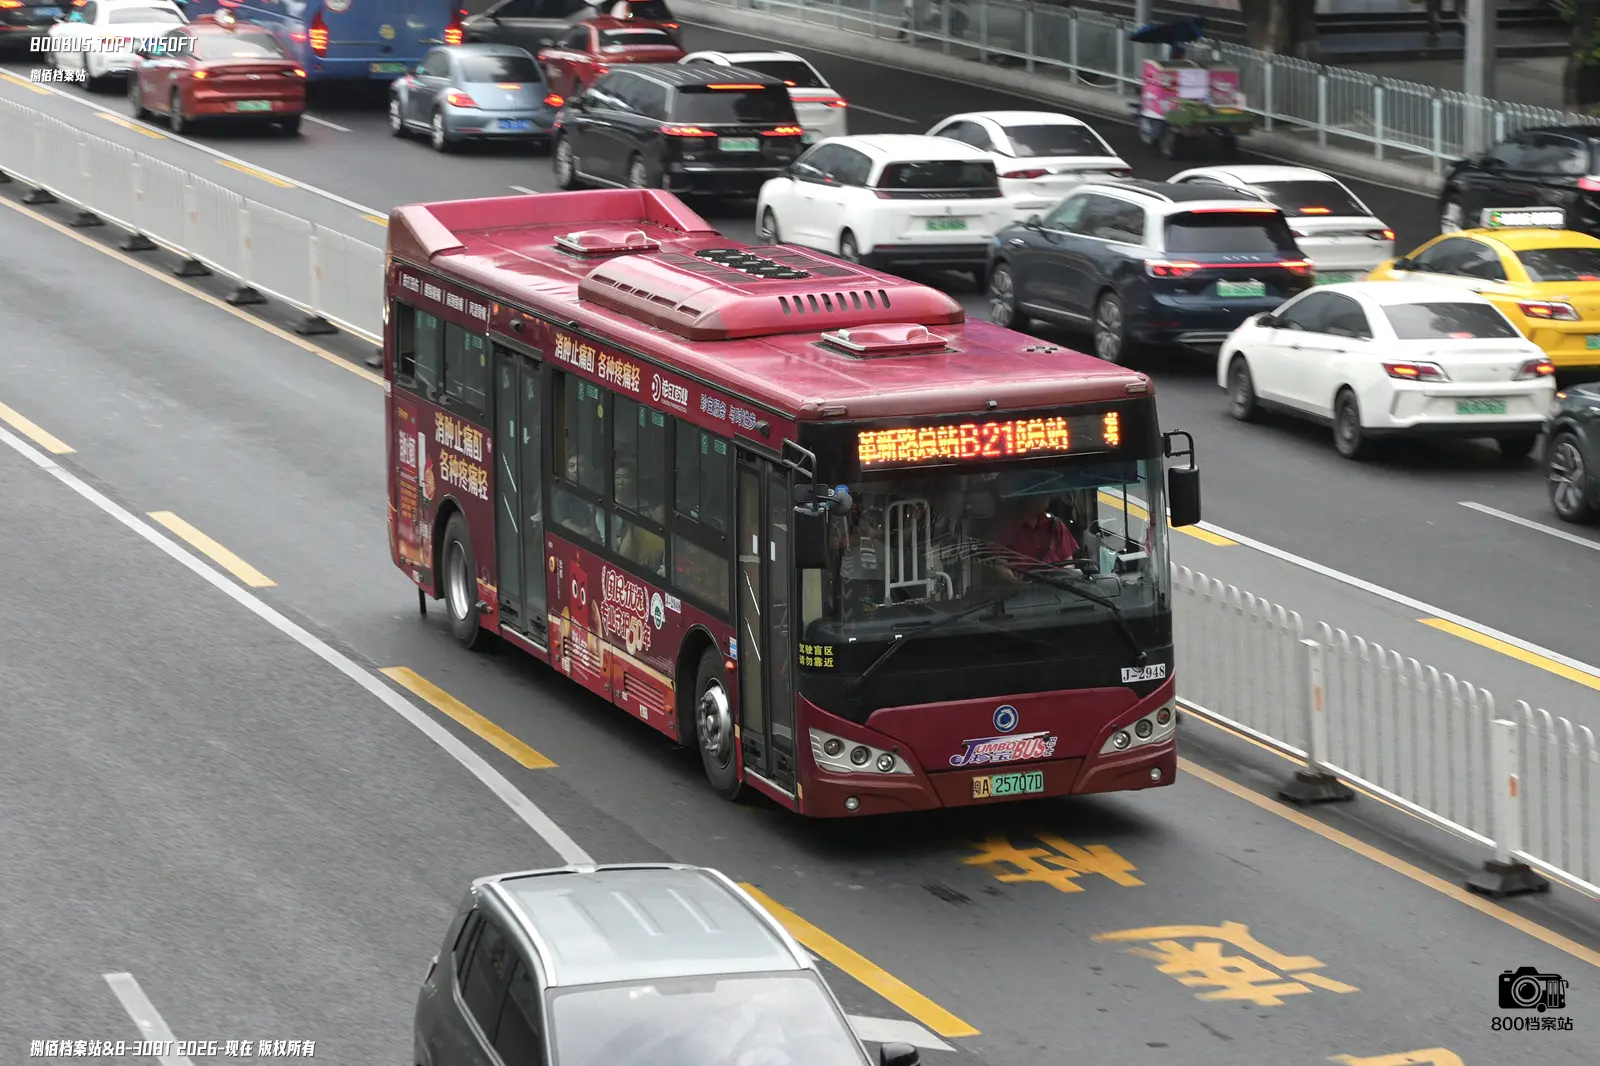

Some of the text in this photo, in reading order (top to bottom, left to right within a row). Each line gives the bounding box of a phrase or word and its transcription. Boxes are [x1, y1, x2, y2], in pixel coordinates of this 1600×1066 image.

[960, 421, 1014, 458] B21
[799, 643, 834, 656] 驾驶盲区
[799, 655, 834, 668] 请勿靠近
[1122, 664, 1166, 682] J-2948
[1011, 736, 1047, 761] BUS
[995, 773, 1043, 794] 25707D
